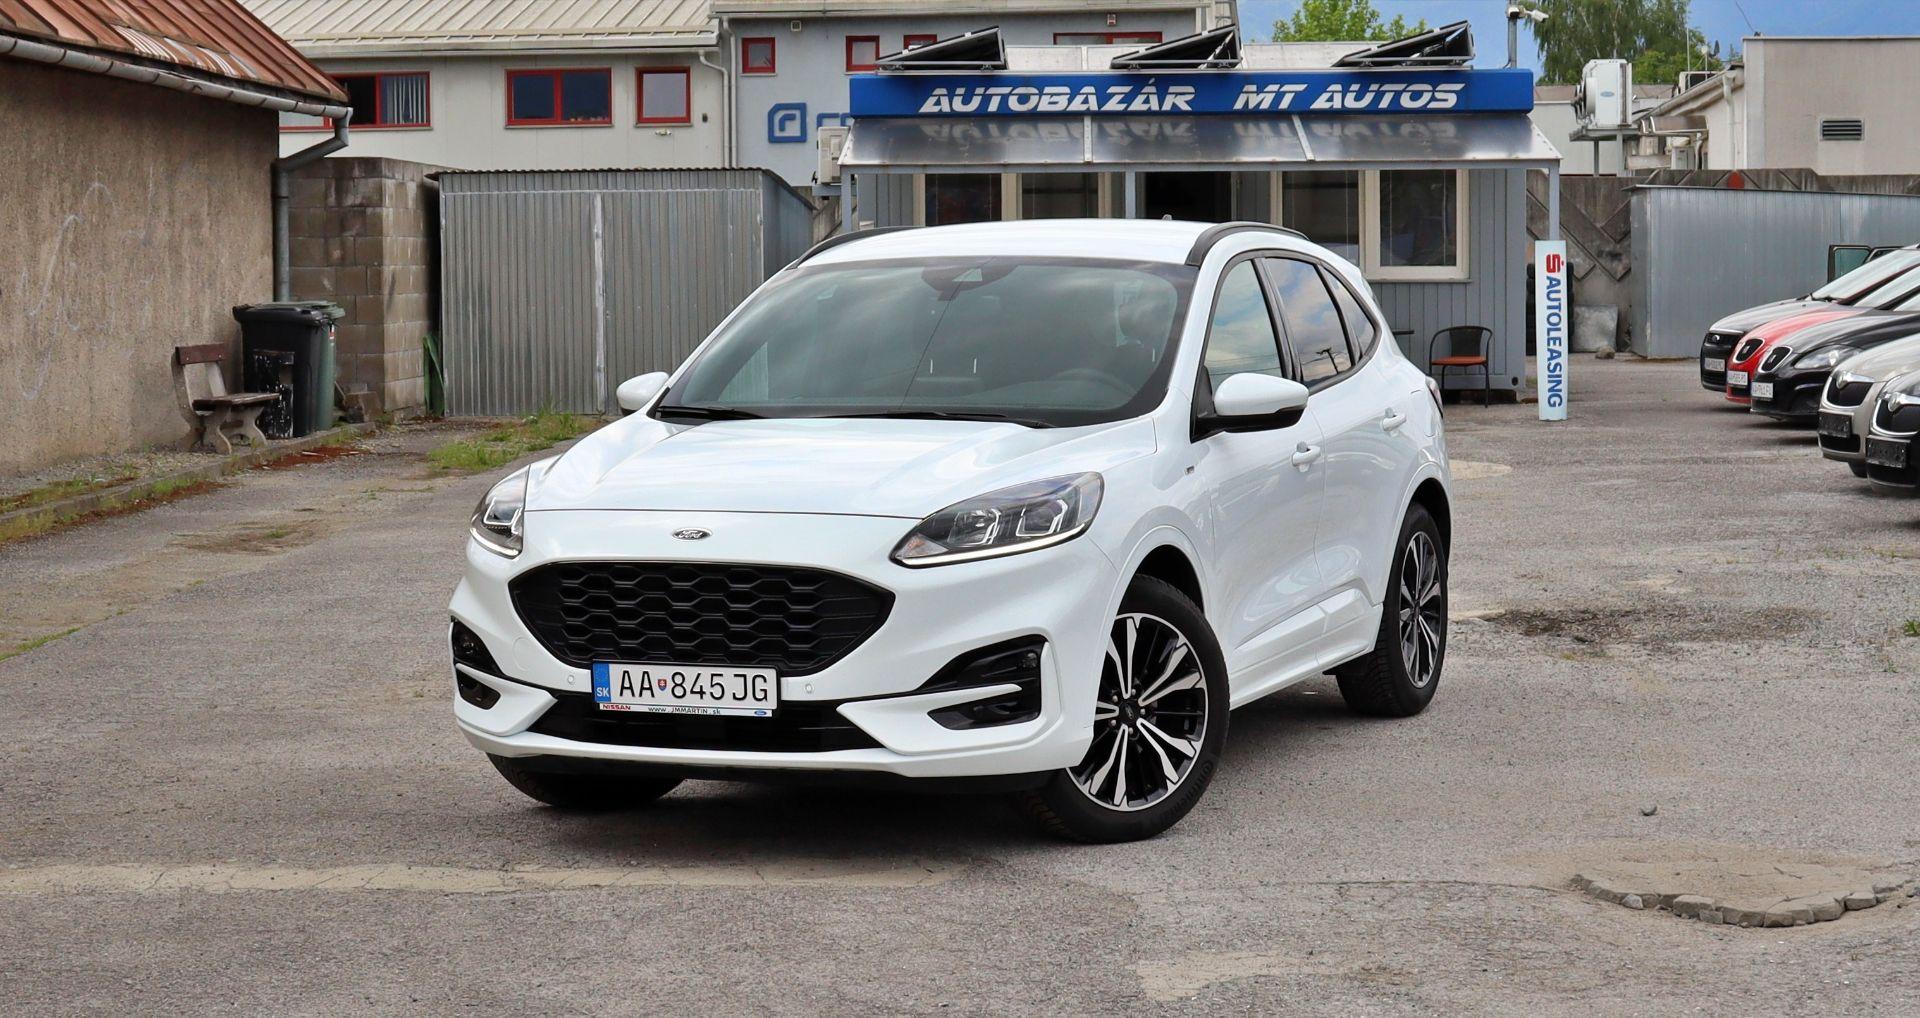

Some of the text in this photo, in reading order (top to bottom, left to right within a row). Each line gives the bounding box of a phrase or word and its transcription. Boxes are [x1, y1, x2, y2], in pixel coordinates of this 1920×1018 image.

[919, 78, 1466, 113] AUTOBAZÁR MT AUTOS
[1546, 276, 1563, 408] AUTOLEASING
[596, 687, 610, 697] SK
